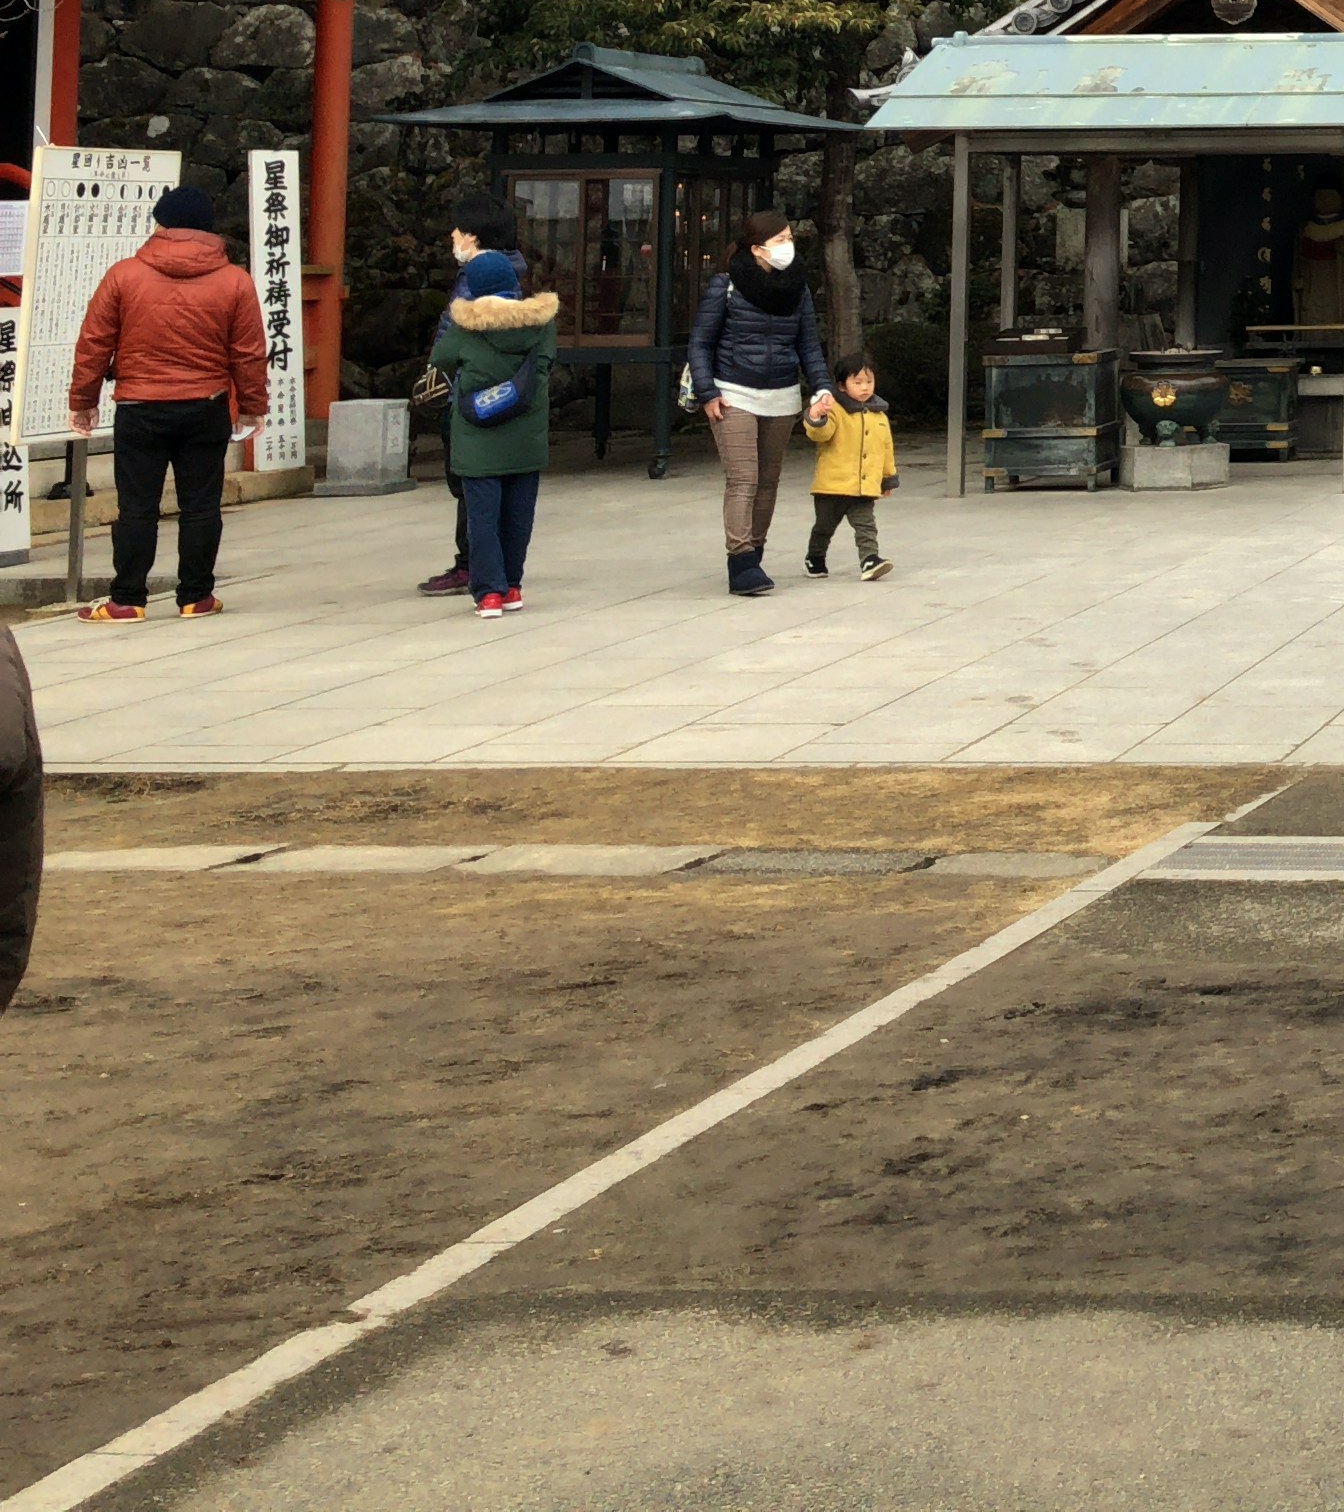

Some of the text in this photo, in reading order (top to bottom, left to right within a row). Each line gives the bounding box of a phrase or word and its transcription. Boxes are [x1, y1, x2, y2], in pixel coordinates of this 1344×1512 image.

[262, 160, 294, 373] 星祭御祈祷受付
